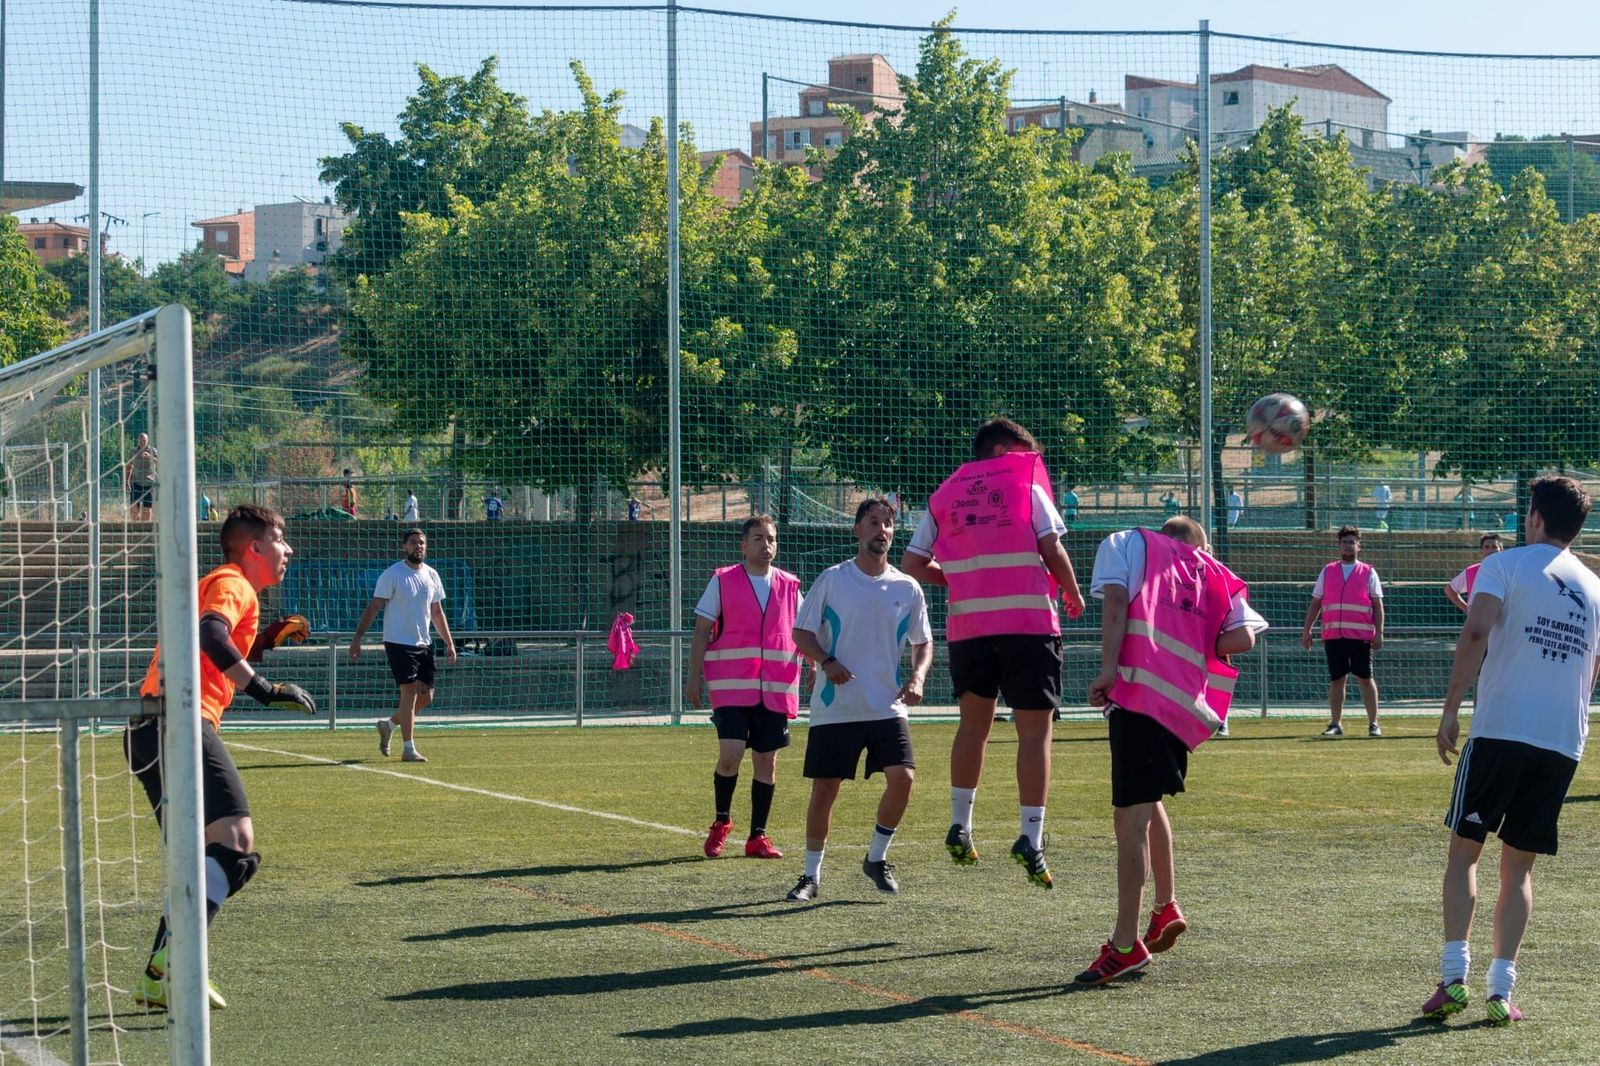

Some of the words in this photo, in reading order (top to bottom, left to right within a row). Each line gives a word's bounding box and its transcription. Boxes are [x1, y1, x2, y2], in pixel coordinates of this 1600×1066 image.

[1537, 616, 1550, 627] SOY
[1533, 626, 1542, 635] ME
[1564, 634, 1573, 643] NO
[1528, 635, 1543, 645] PERO
[1544, 638, 1557, 648] ESTE
[1558, 642, 1570, 652] AÑO
